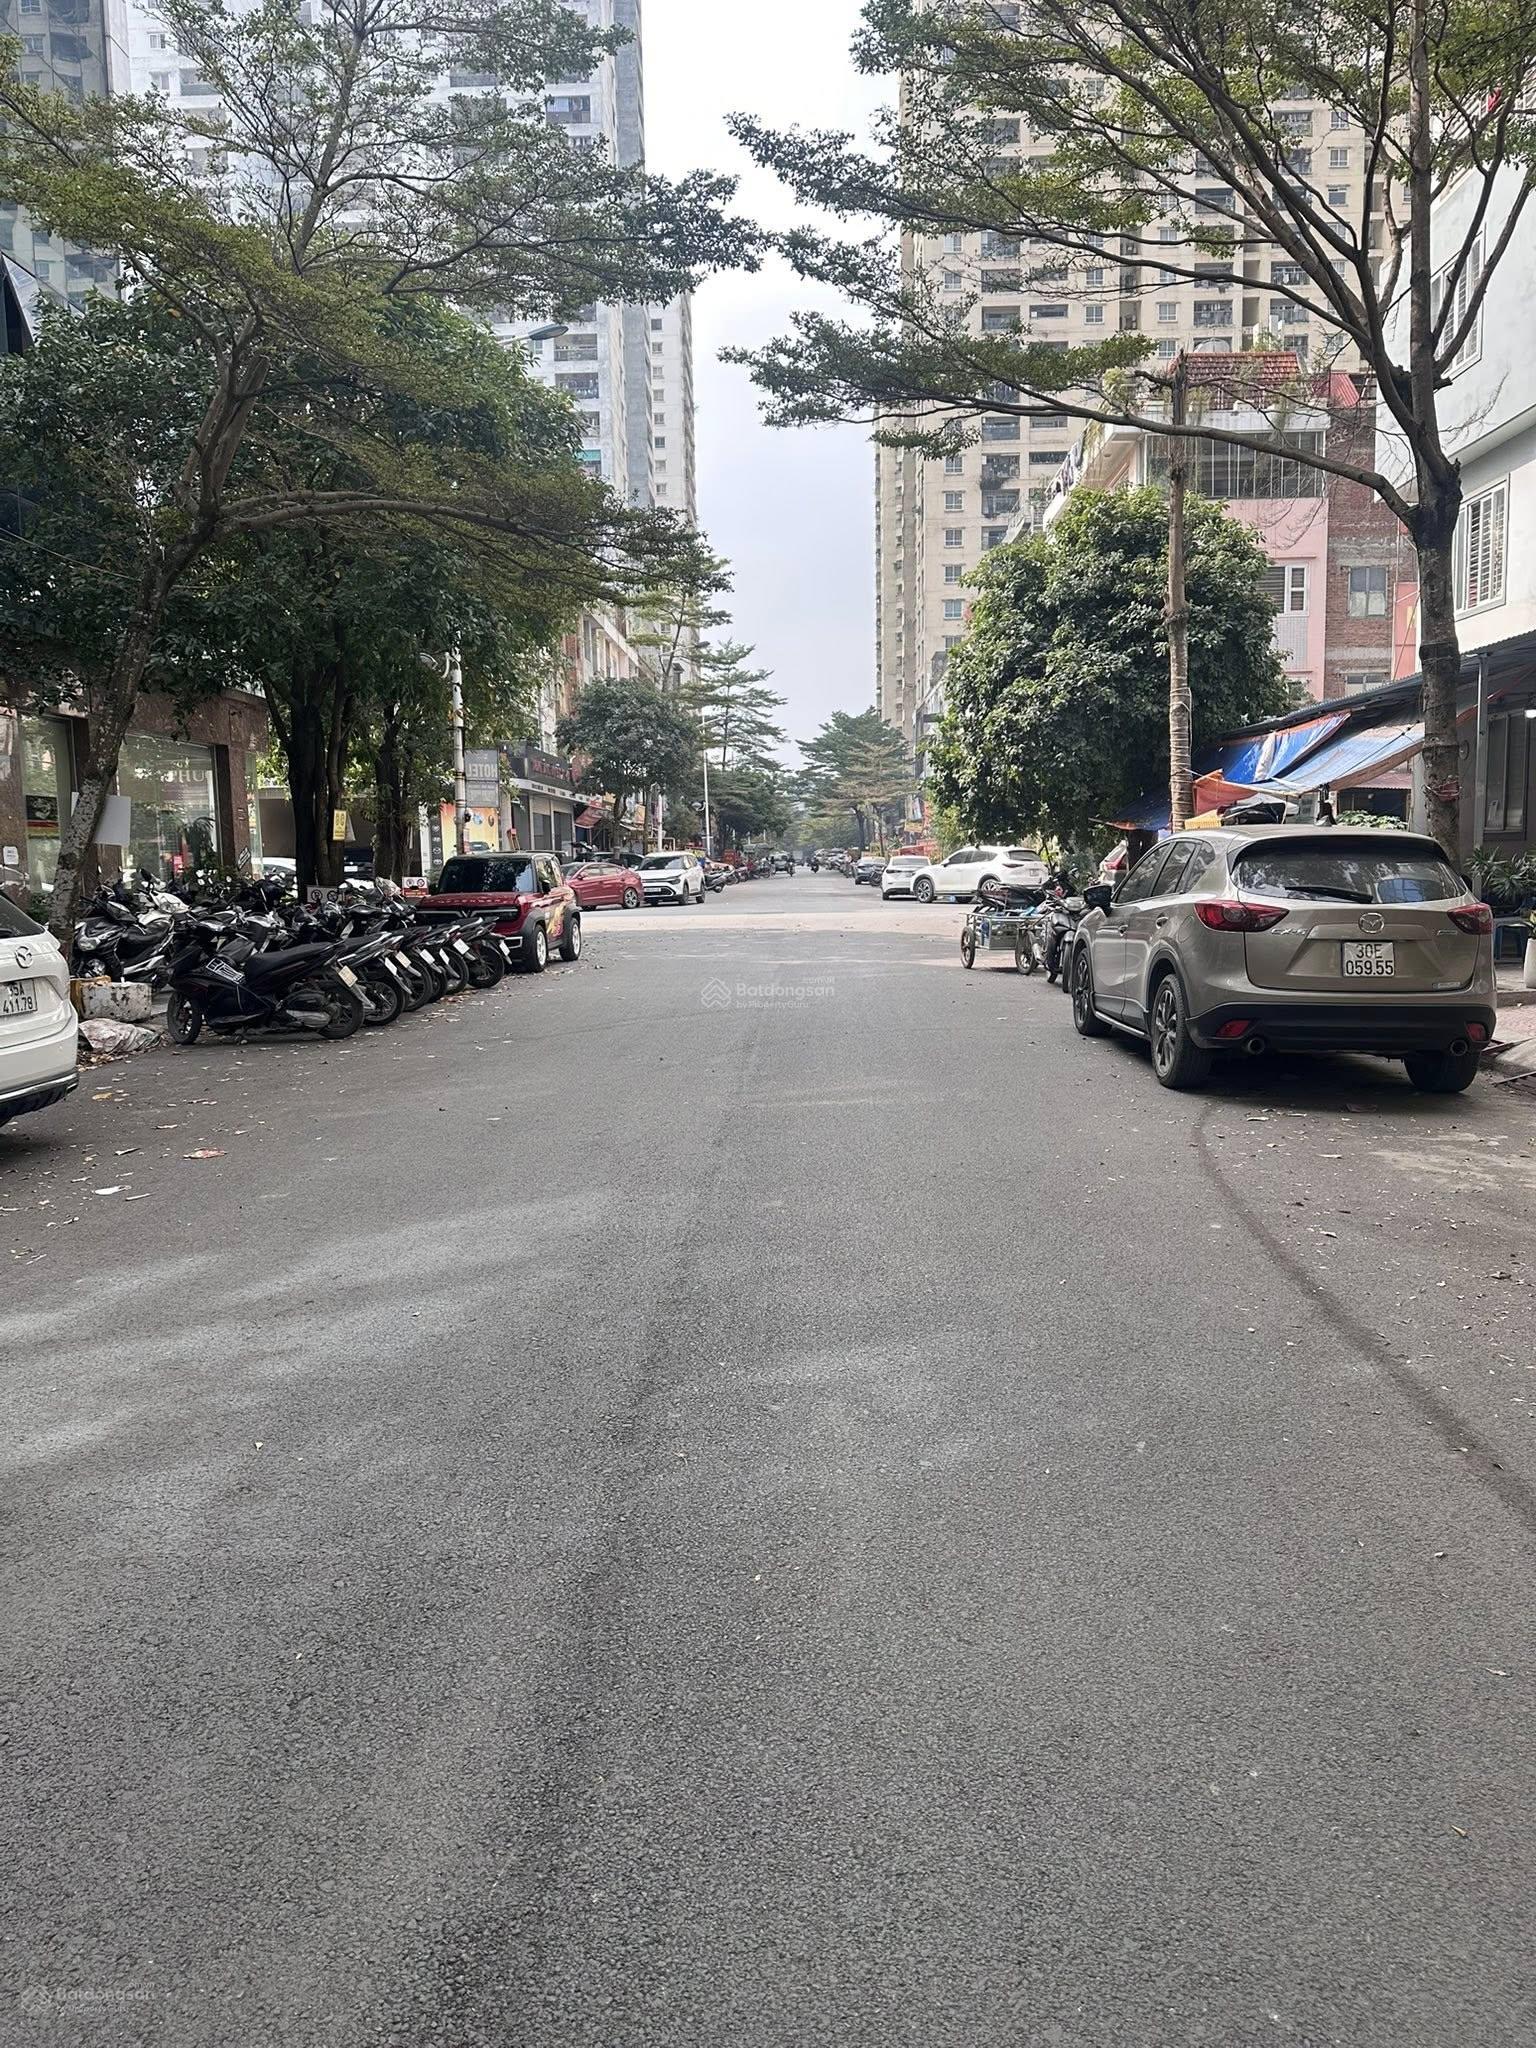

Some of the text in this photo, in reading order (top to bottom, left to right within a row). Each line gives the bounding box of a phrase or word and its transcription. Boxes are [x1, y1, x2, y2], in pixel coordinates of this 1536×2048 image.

[1356, 943, 1383, 959] 30E
[1345, 960, 1394, 976] 059.55
[3, 996, 33, 1013] 411.78
